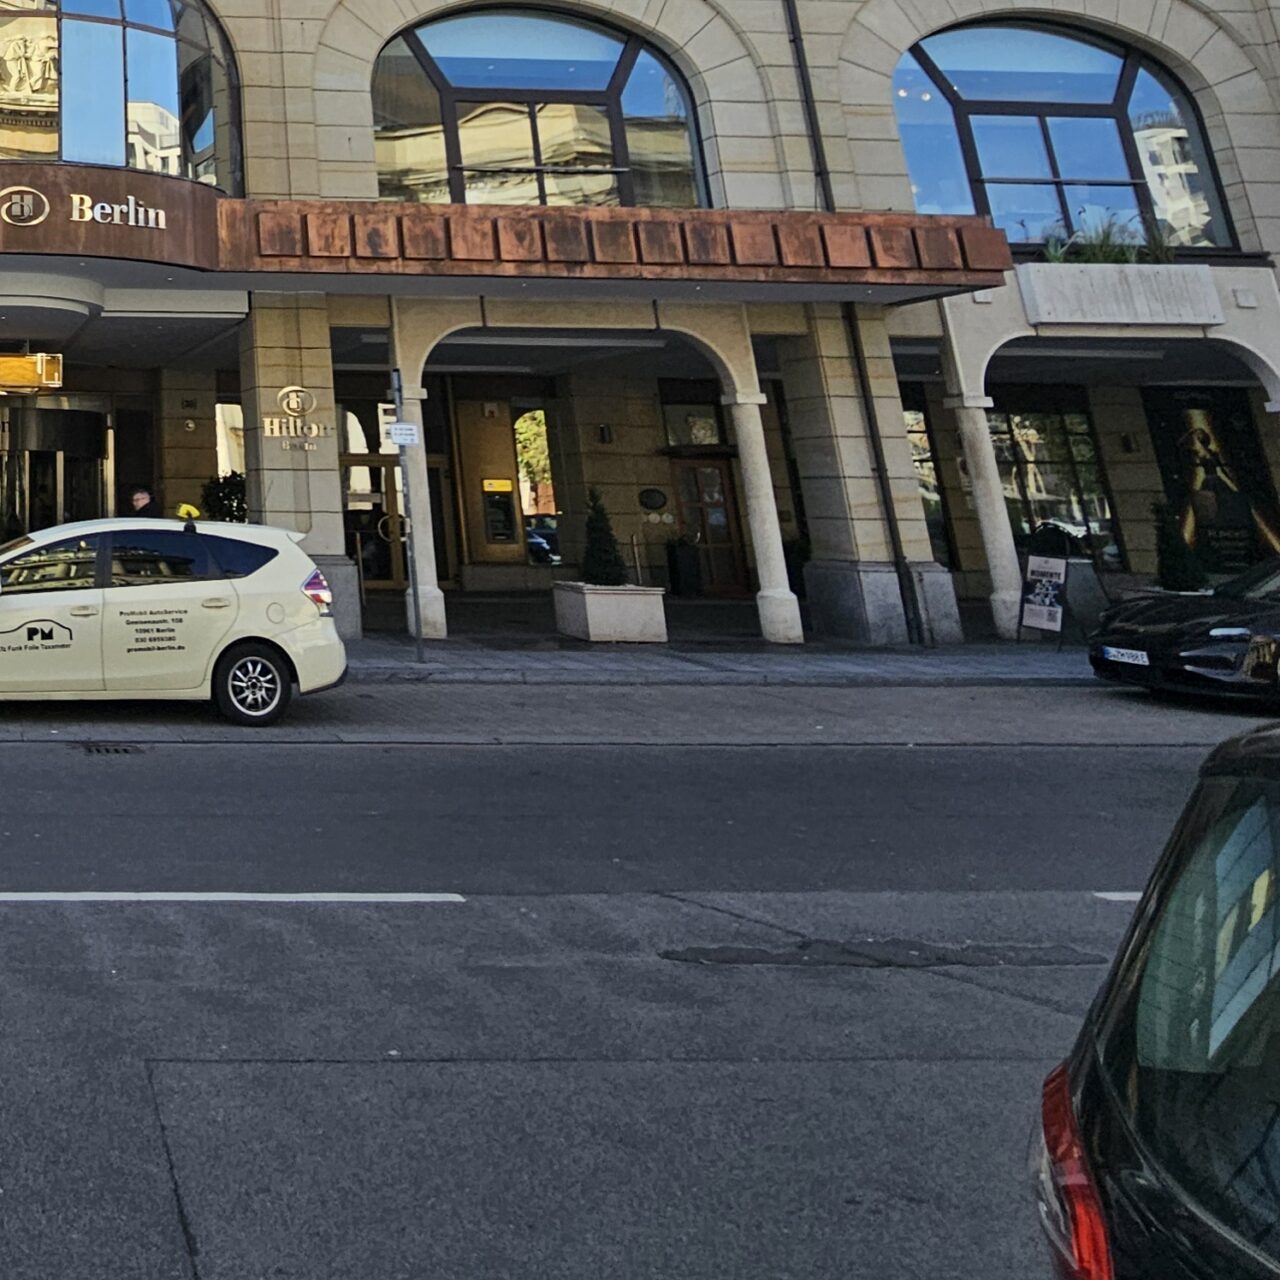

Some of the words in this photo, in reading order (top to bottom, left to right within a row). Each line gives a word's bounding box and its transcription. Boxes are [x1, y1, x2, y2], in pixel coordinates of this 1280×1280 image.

[70, 193, 167, 230] Berlin
[262, 416, 332, 438] Hilton
[27, 627, 54, 641] PM
